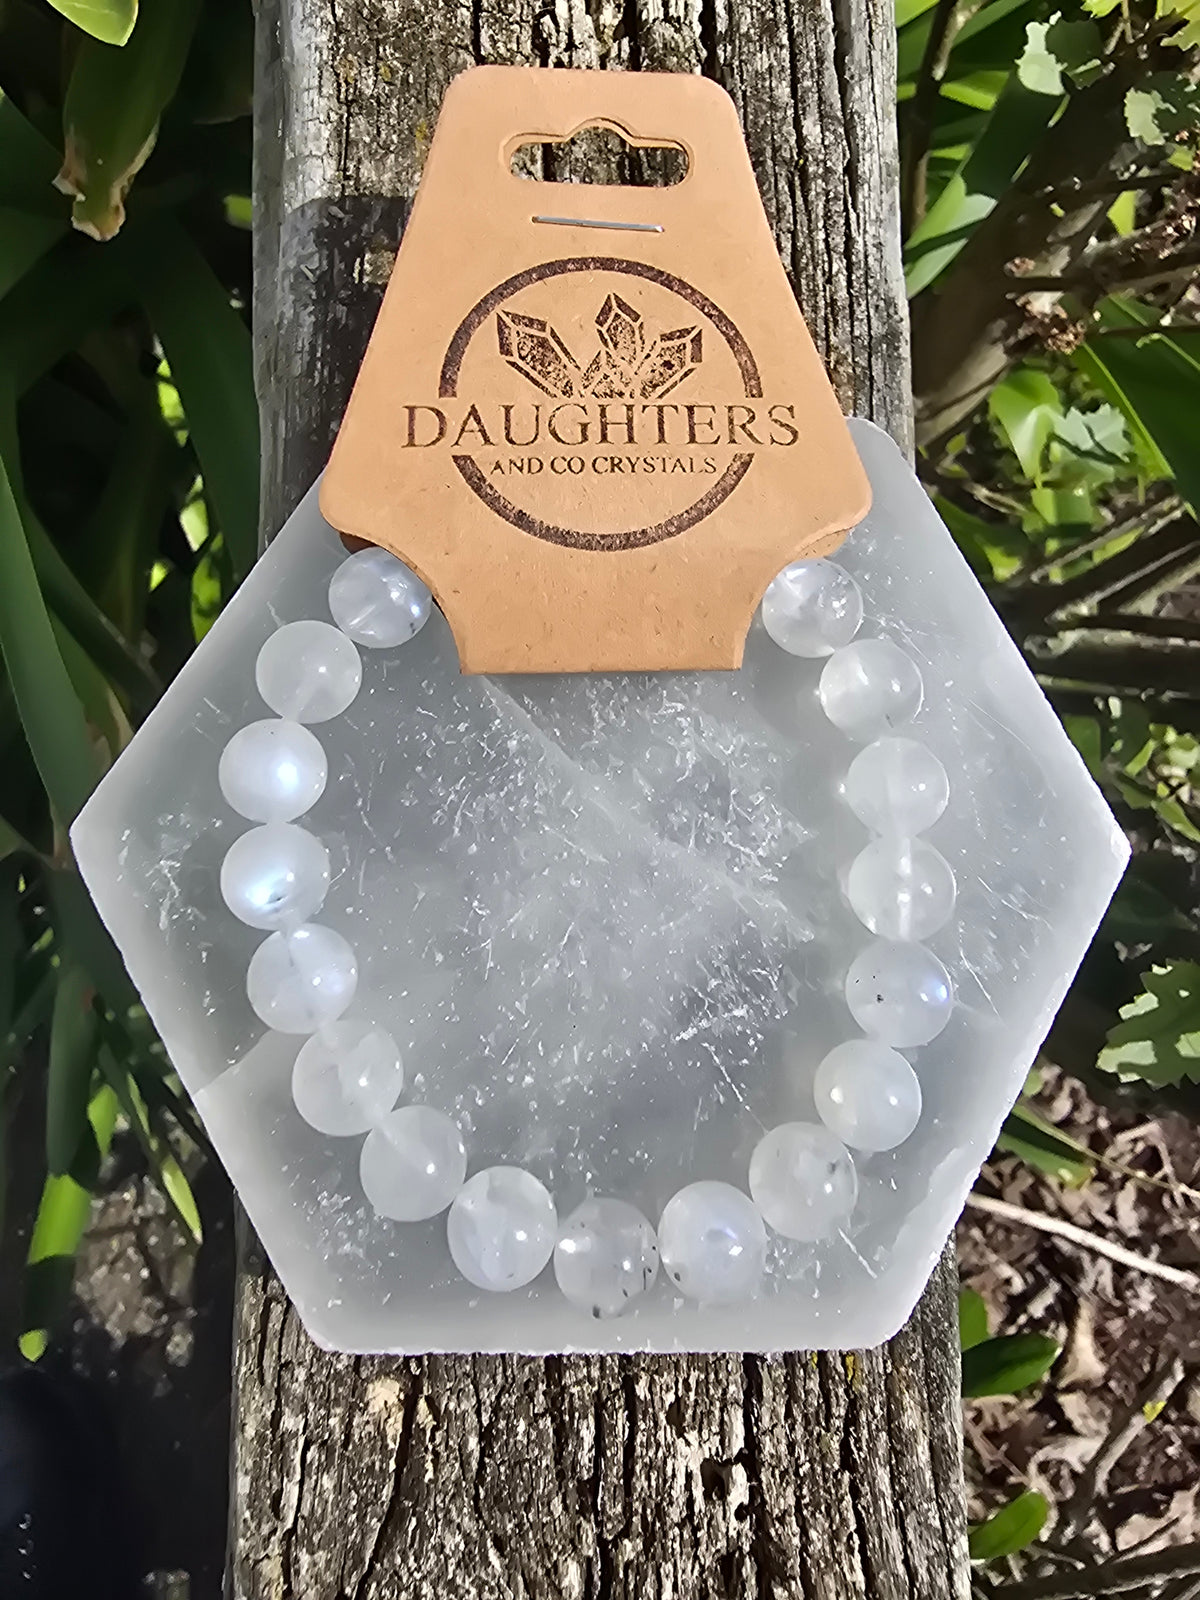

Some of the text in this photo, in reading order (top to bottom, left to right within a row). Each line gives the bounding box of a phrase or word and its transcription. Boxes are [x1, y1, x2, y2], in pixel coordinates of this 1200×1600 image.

[401, 403, 800, 448] DAUGHTERS
[490, 455, 717, 476] AND CO CRYSTALS
